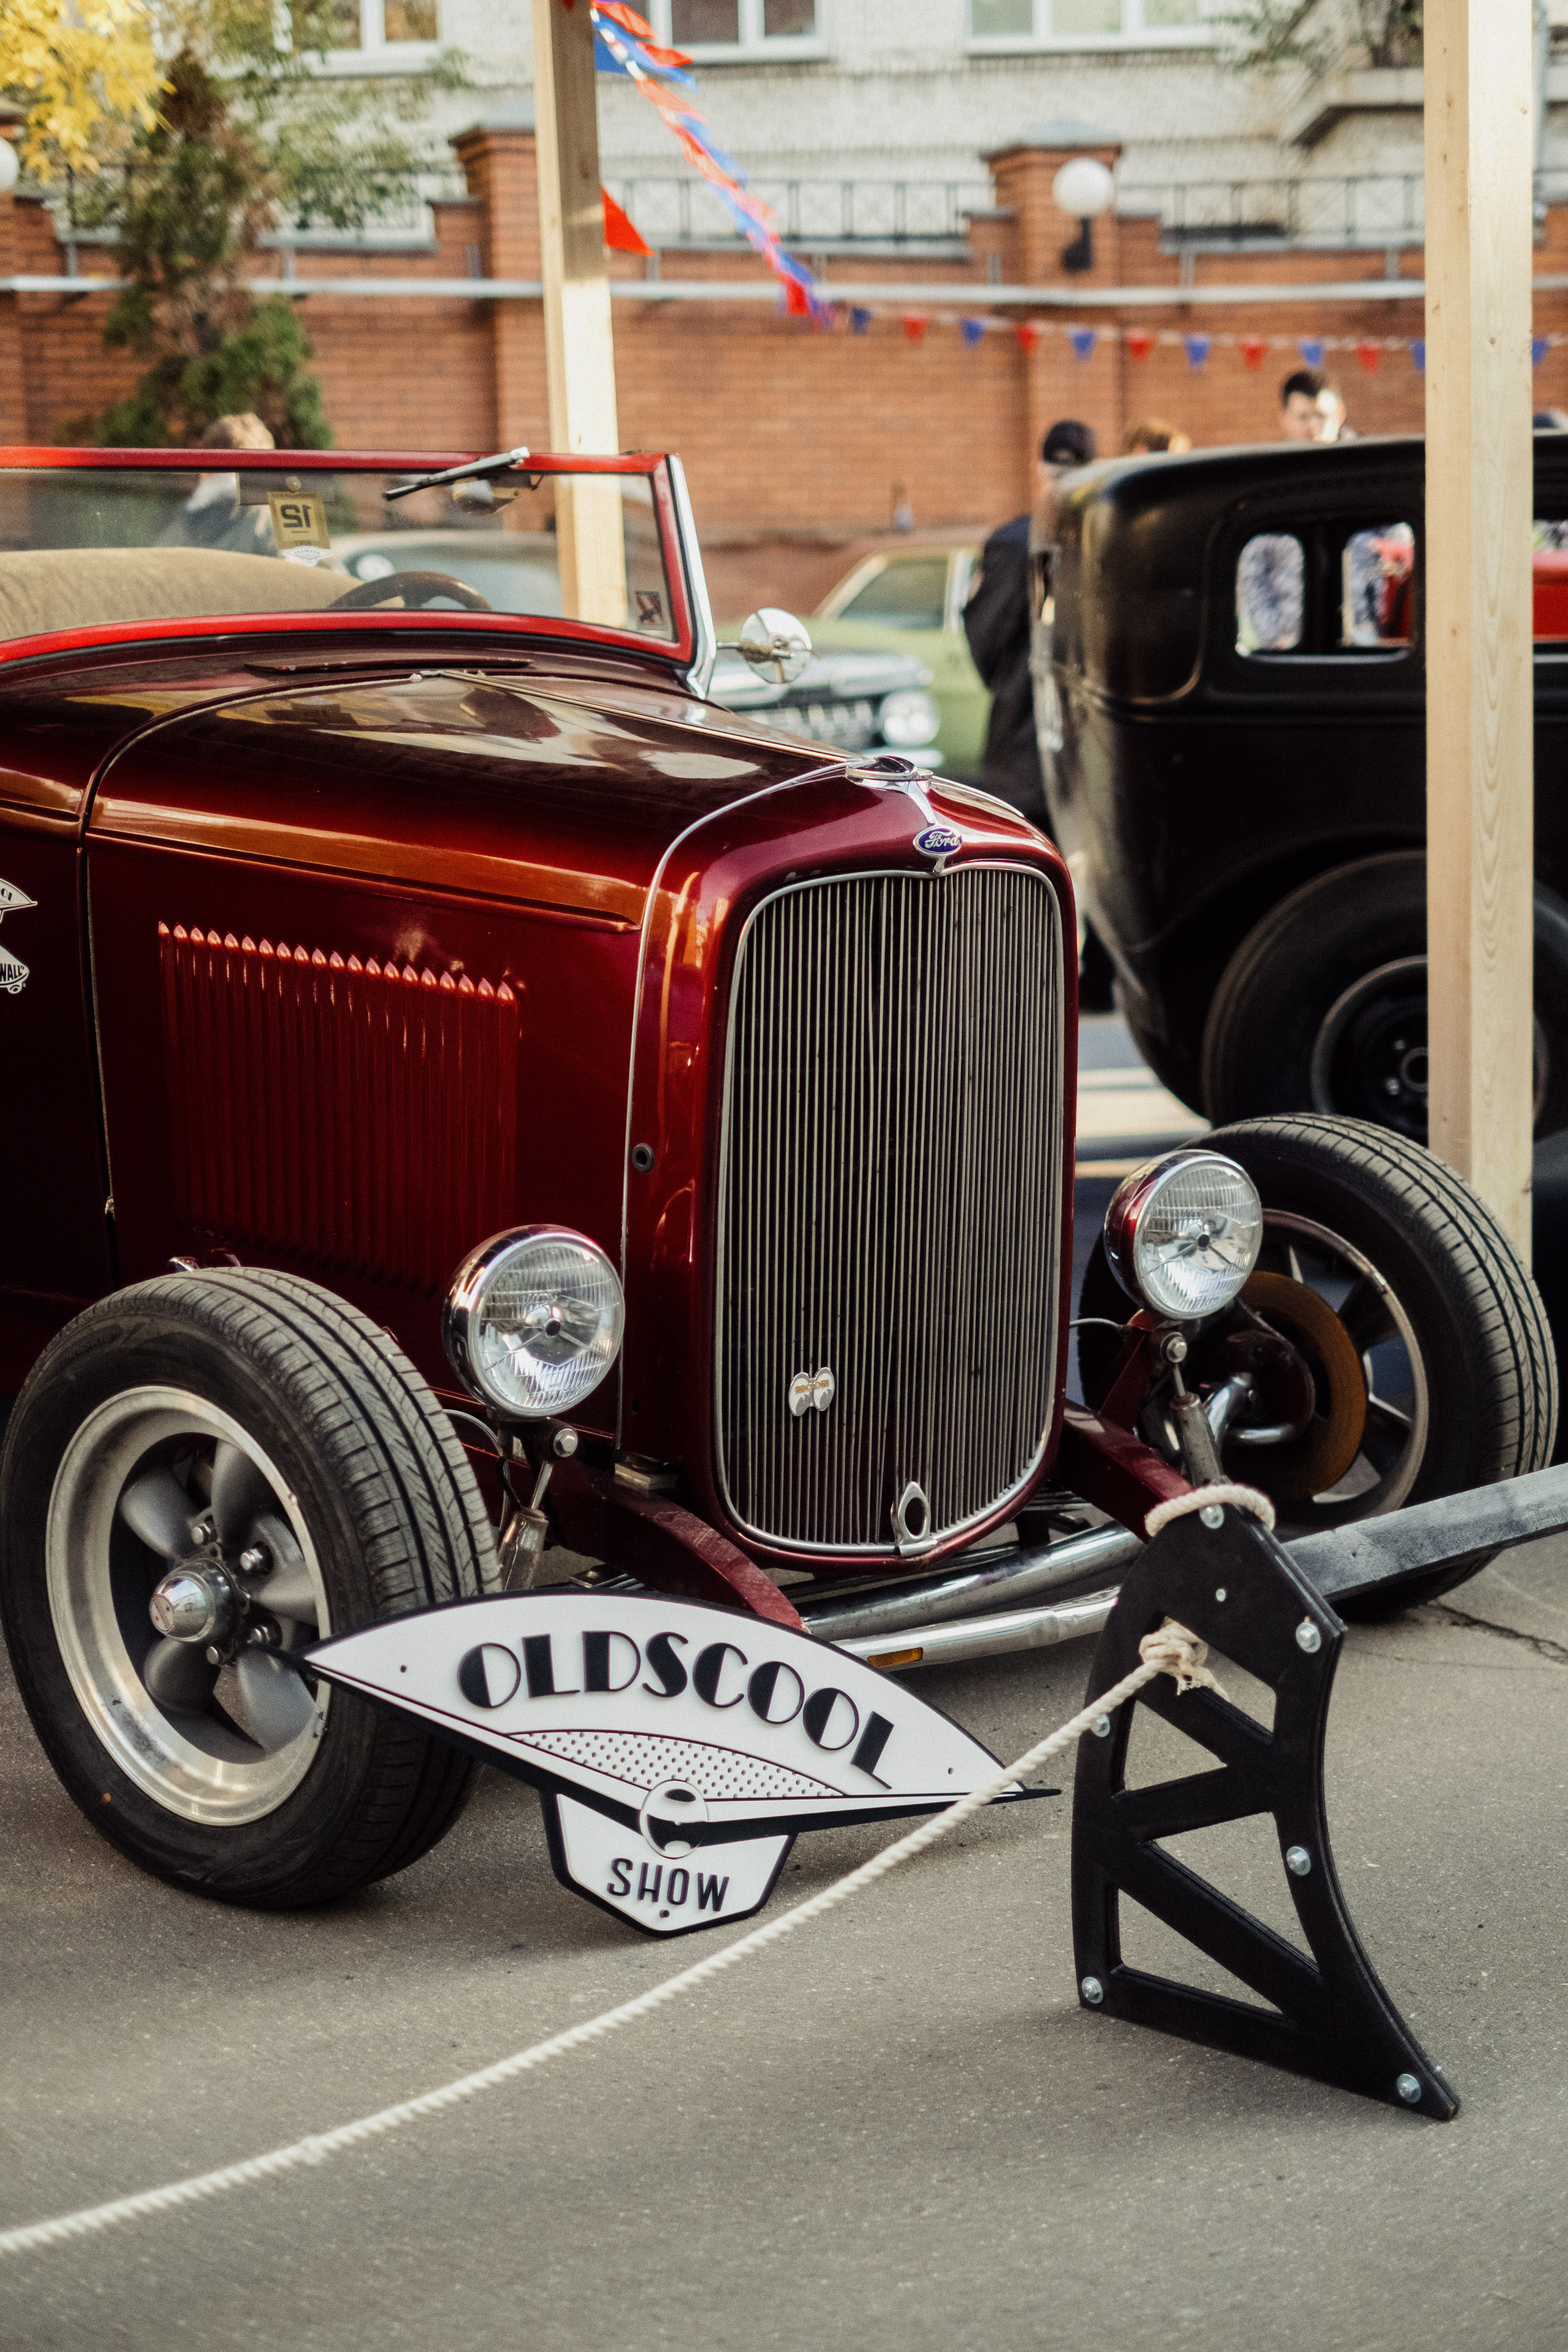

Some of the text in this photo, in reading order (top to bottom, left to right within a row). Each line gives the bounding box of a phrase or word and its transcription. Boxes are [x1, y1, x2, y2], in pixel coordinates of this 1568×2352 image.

[925, 831, 960, 848] Ford
[795, 1379, 829, 1394] MOON
[458, 1630, 895, 1790] OLDSCOOL
[606, 1856, 731, 1913] SHOW
